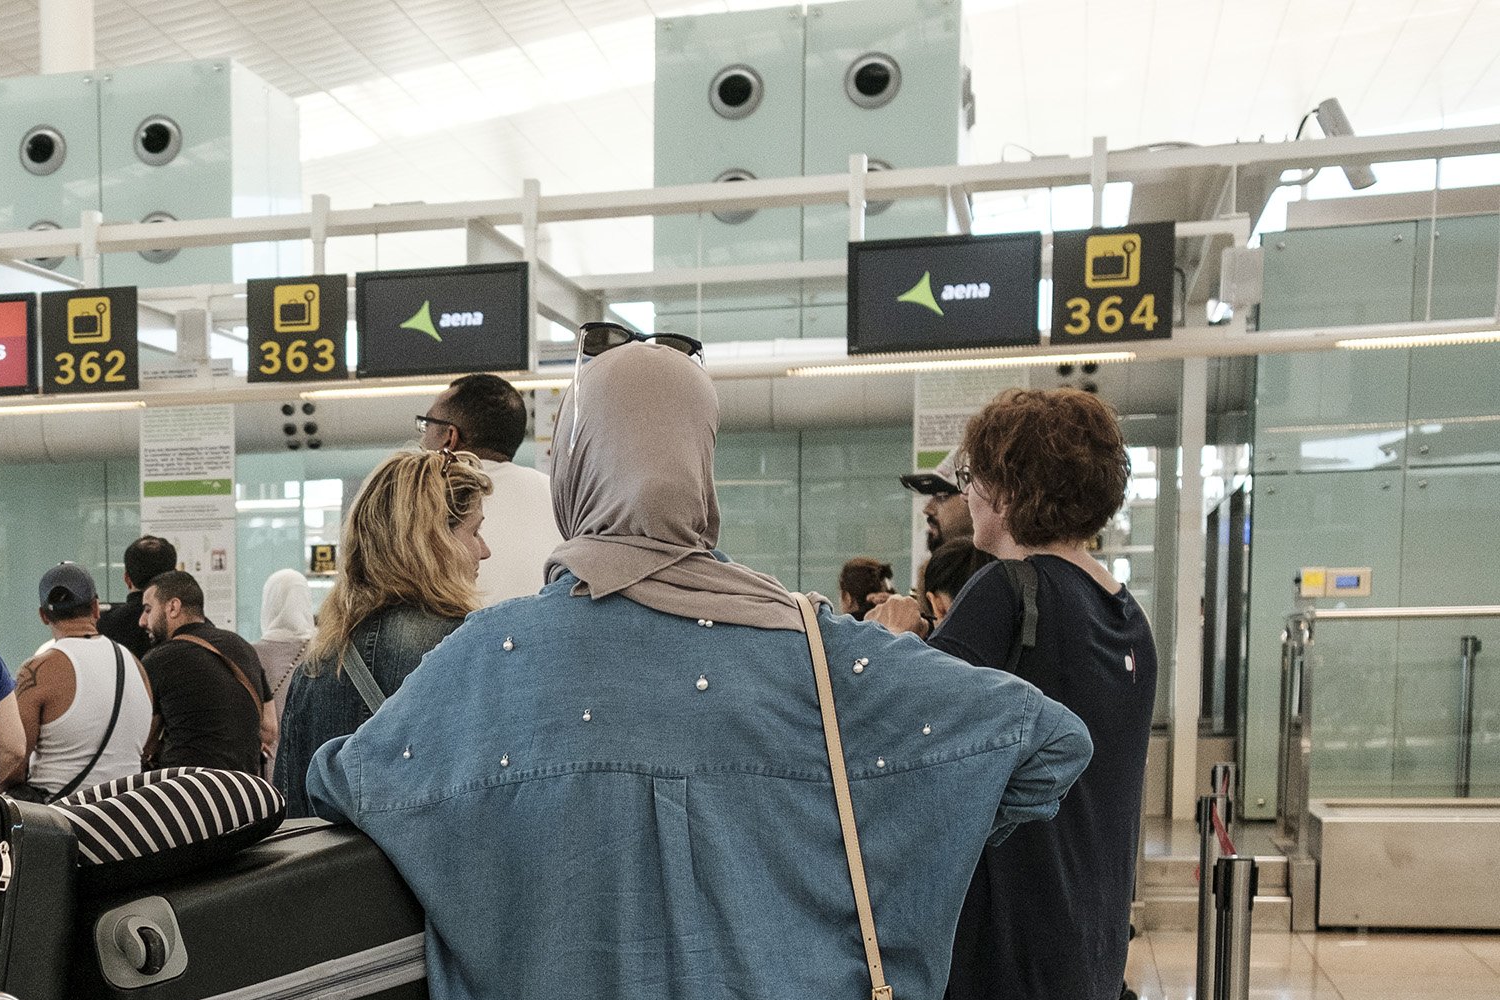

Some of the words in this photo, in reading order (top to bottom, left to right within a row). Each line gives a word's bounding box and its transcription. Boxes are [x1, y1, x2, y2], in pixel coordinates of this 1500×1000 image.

[940, 280, 991, 300] aena
[439, 310, 484, 328] aena
[1064, 293, 1159, 336] 364
[54, 349, 127, 385] 362
[259, 338, 336, 375] 363
